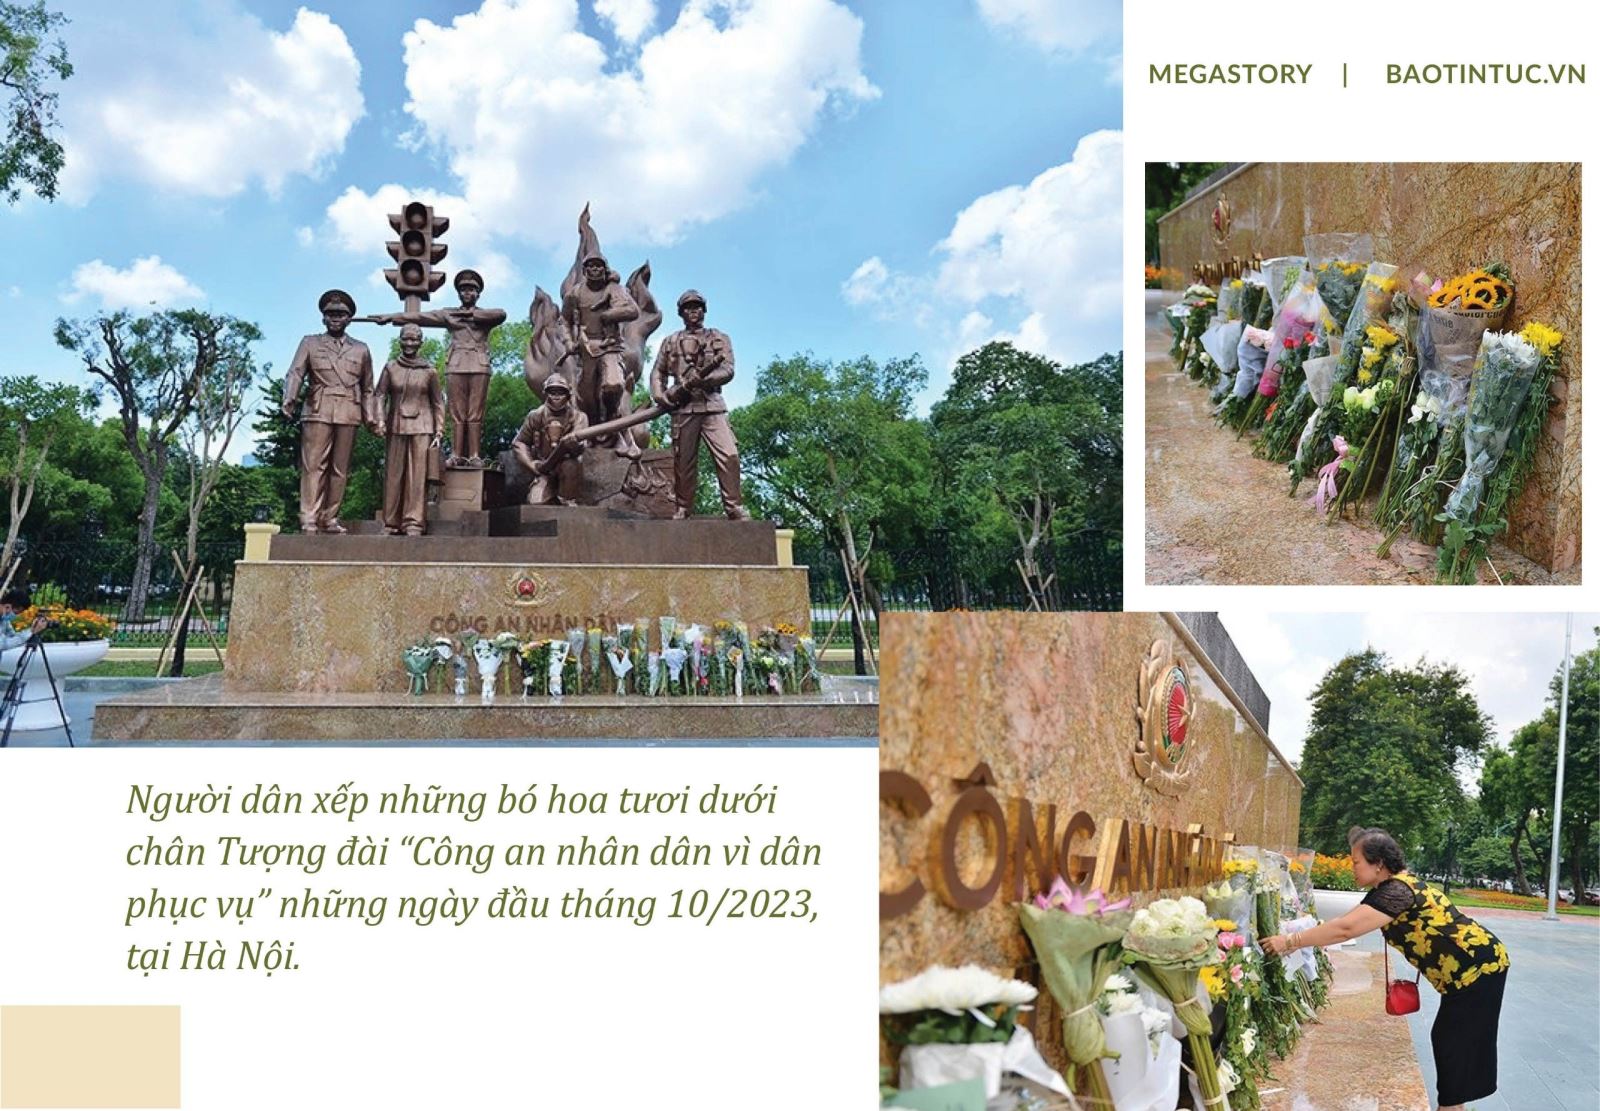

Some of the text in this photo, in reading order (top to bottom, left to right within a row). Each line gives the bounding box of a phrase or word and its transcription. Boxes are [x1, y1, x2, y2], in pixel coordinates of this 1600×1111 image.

[430, 613, 488, 633] CÔNG
[494, 616, 520, 632] AN
[526, 613, 577, 633] NHÂN
